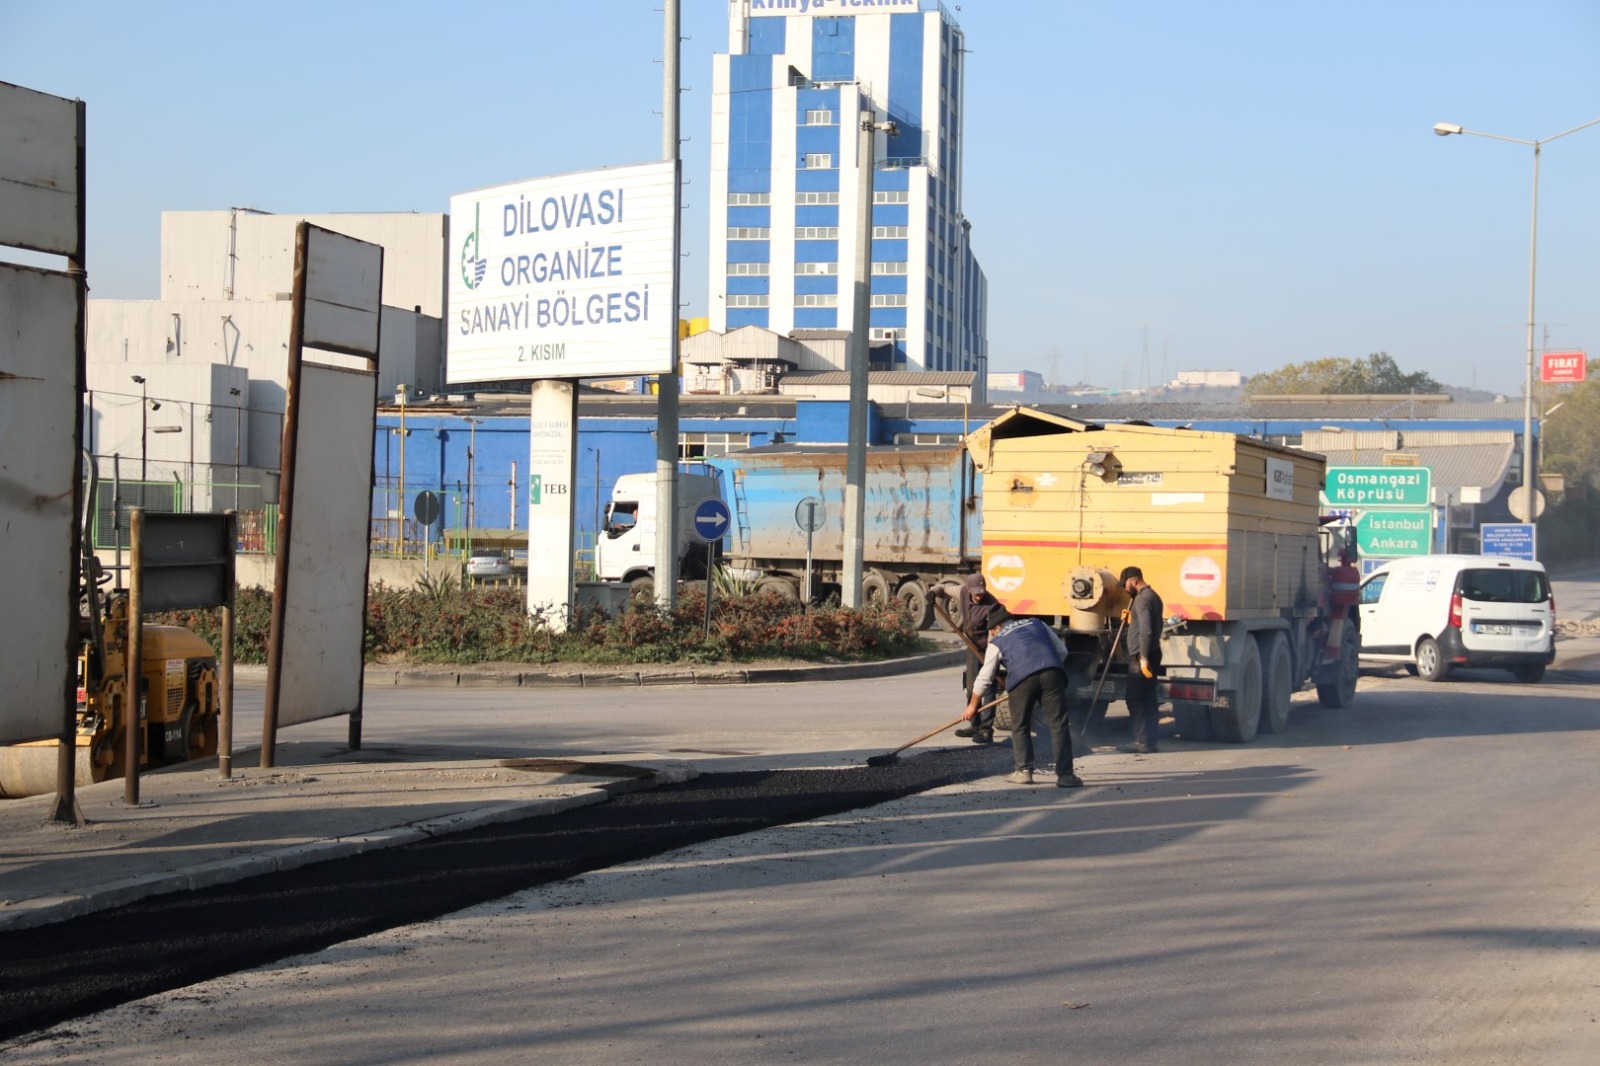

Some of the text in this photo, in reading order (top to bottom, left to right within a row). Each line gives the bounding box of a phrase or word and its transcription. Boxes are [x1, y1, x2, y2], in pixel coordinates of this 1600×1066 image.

[503, 188, 624, 237] DİLOVASI
[501, 241, 622, 287] ORGANİZE
[460, 283, 650, 336] SANAYİ BÖLGESİ
[517, 342, 566, 362] 2. KISIM
[1548, 358, 1578, 368] FIRAT
[1337, 473, 1421, 488] Osmangazi
[544, 484, 567, 494] TEB
[1336, 487, 1405, 502] Köprüsü
[1369, 514, 1424, 530] İstanbul
[1369, 537, 1418, 550] Ankara
